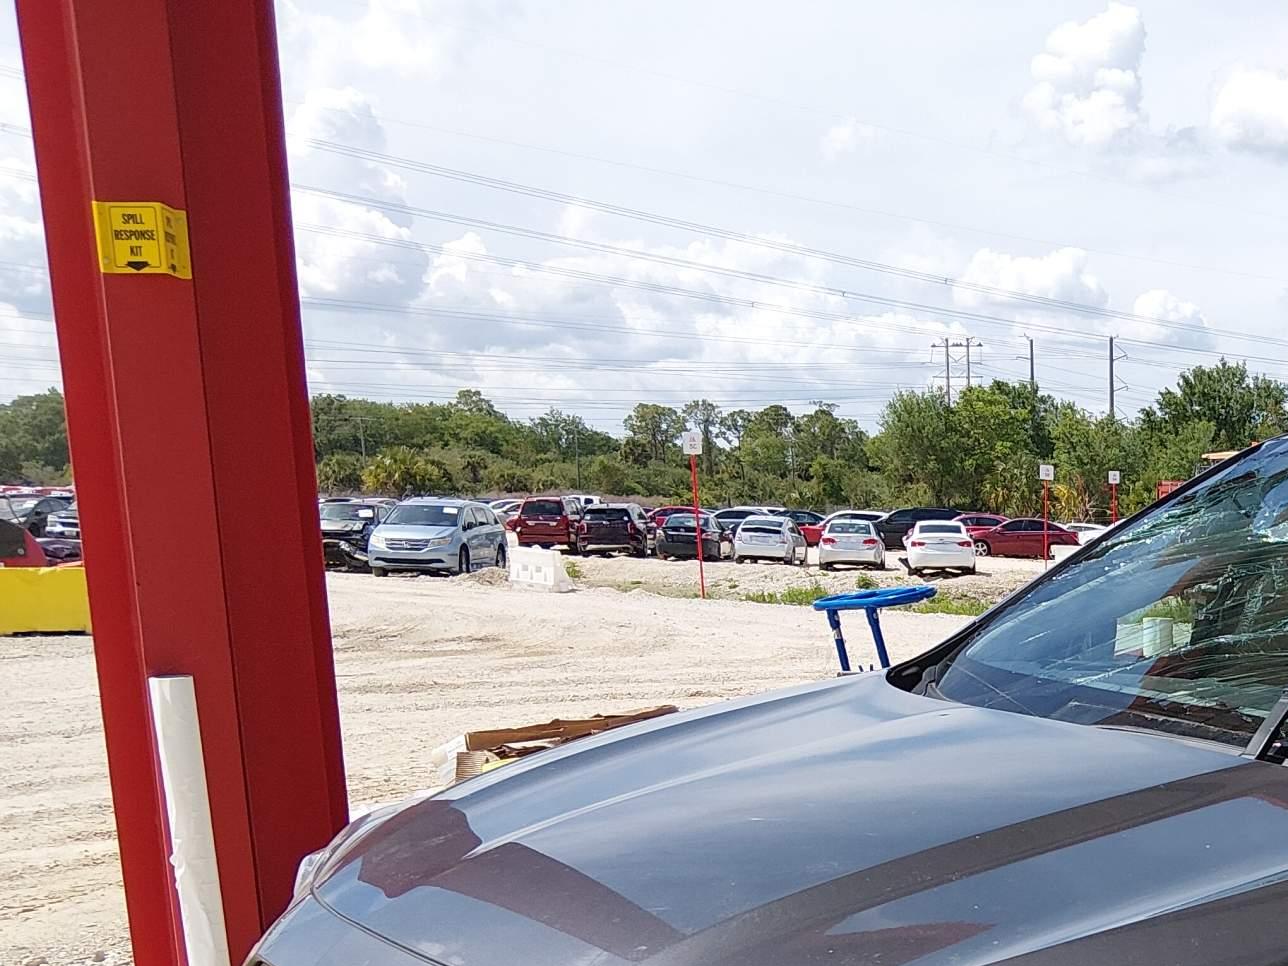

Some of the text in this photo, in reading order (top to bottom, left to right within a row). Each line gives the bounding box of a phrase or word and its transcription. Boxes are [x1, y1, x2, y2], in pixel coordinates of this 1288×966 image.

[121, 213, 145, 225] SPILL
[113, 229, 157, 241] RESPONSE
[129, 245, 143, 257] KIT
